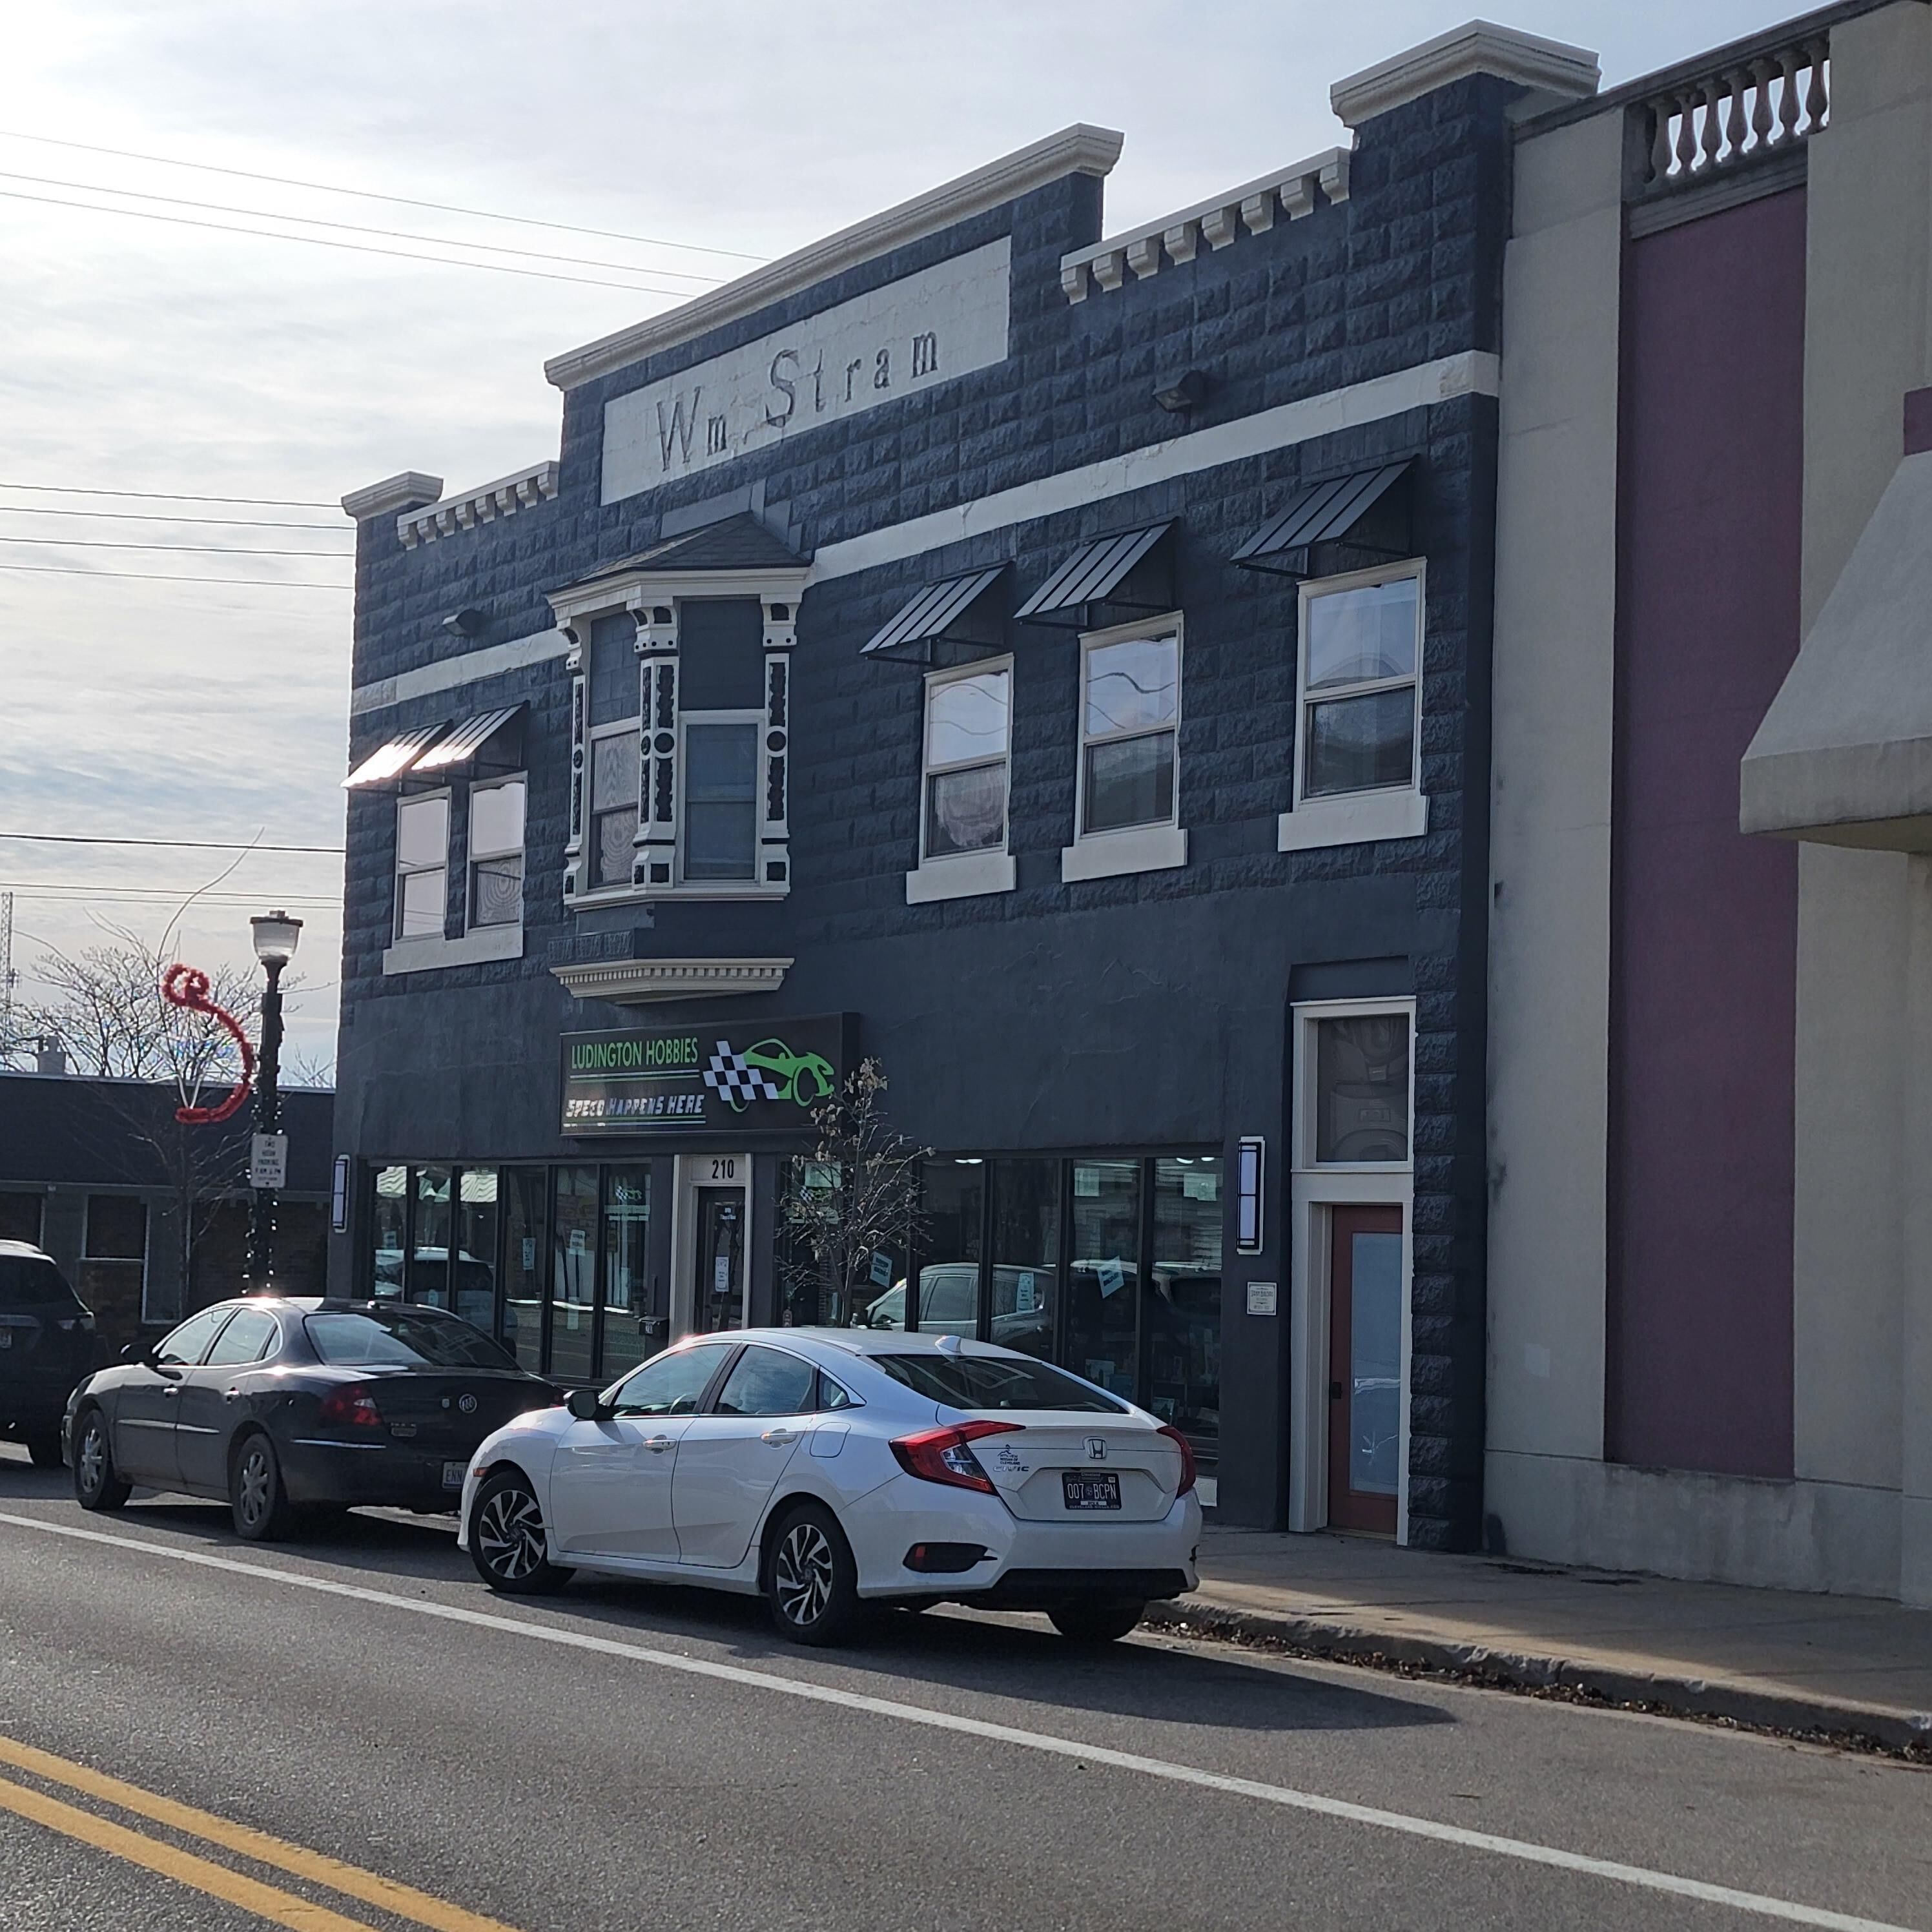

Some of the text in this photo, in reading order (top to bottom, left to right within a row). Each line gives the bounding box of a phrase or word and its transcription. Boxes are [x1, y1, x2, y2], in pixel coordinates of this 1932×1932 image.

[764, 330, 938, 429] Stram
[571, 1037, 698, 1069] LUDINGTON HOBBIES
[606, 1096, 664, 1116] HAPPENS
[666, 1094, 705, 1115] HERE
[712, 1159, 734, 1179] 210
[446, 1468, 465, 1483] ENN
[1067, 1483, 1117, 1500] 007 BCPN
